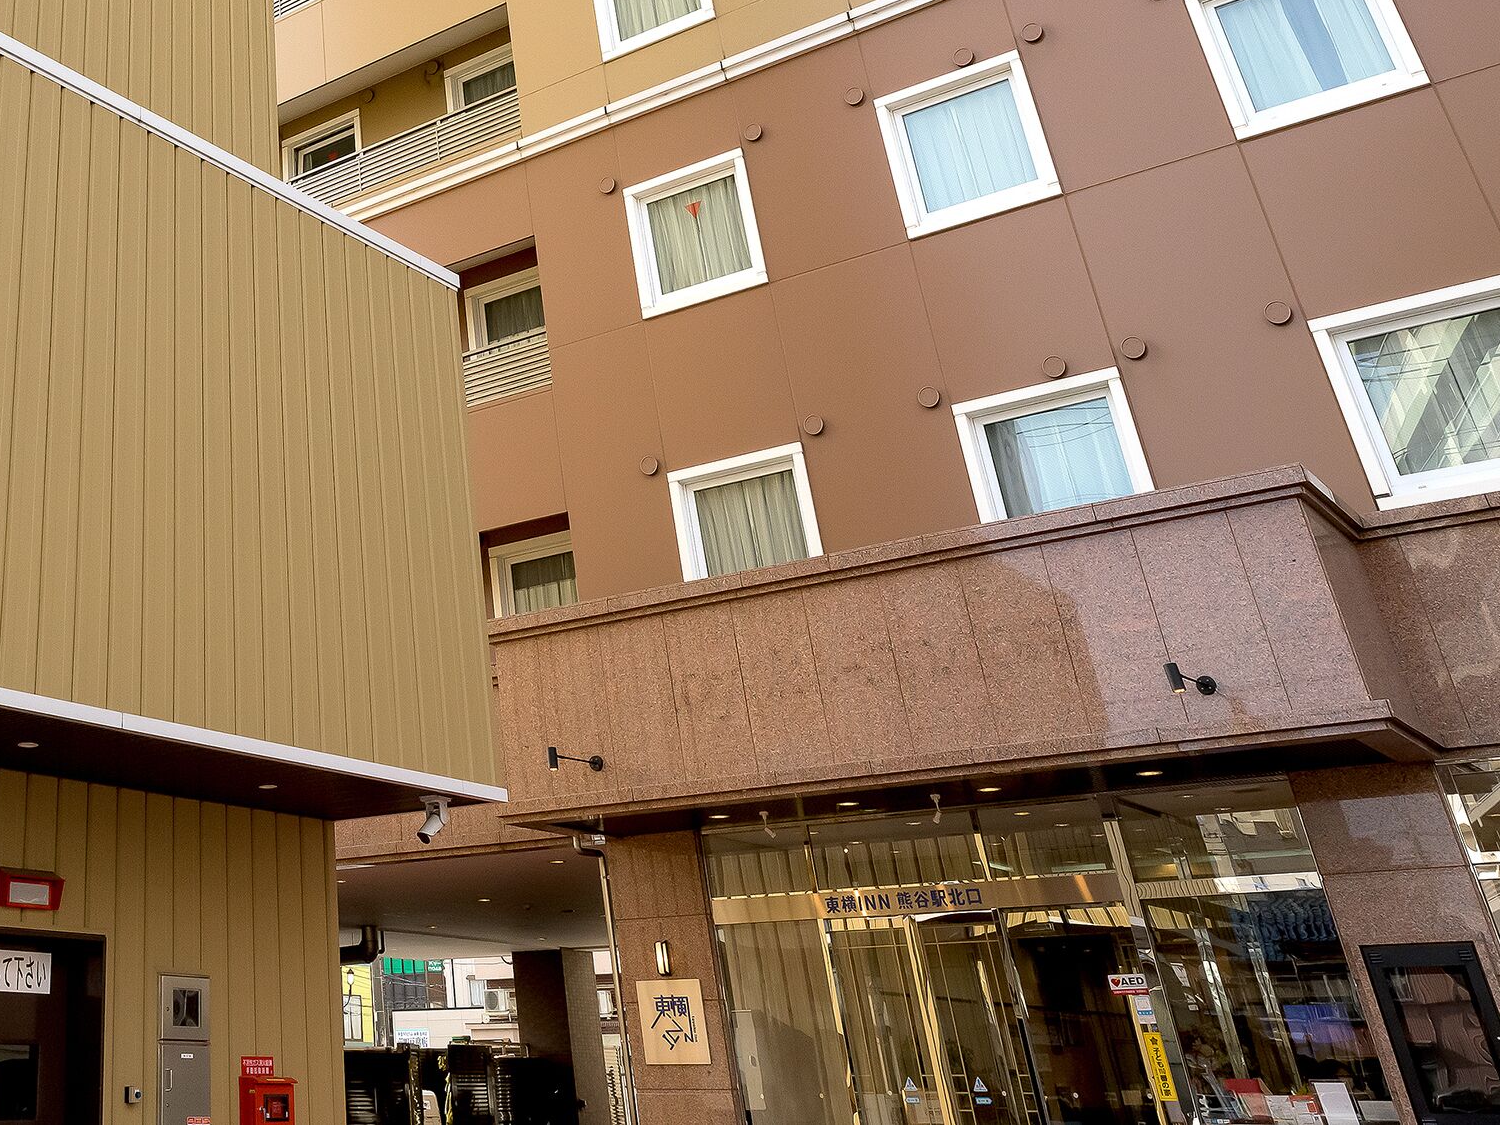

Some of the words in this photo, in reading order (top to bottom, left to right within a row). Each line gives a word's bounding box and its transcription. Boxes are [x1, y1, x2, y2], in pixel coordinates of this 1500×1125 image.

[825, 894, 891, 914] 東横INN
[896, 888, 982, 909] 熊谷駅北口
[1121, 977, 1144, 986] AED
